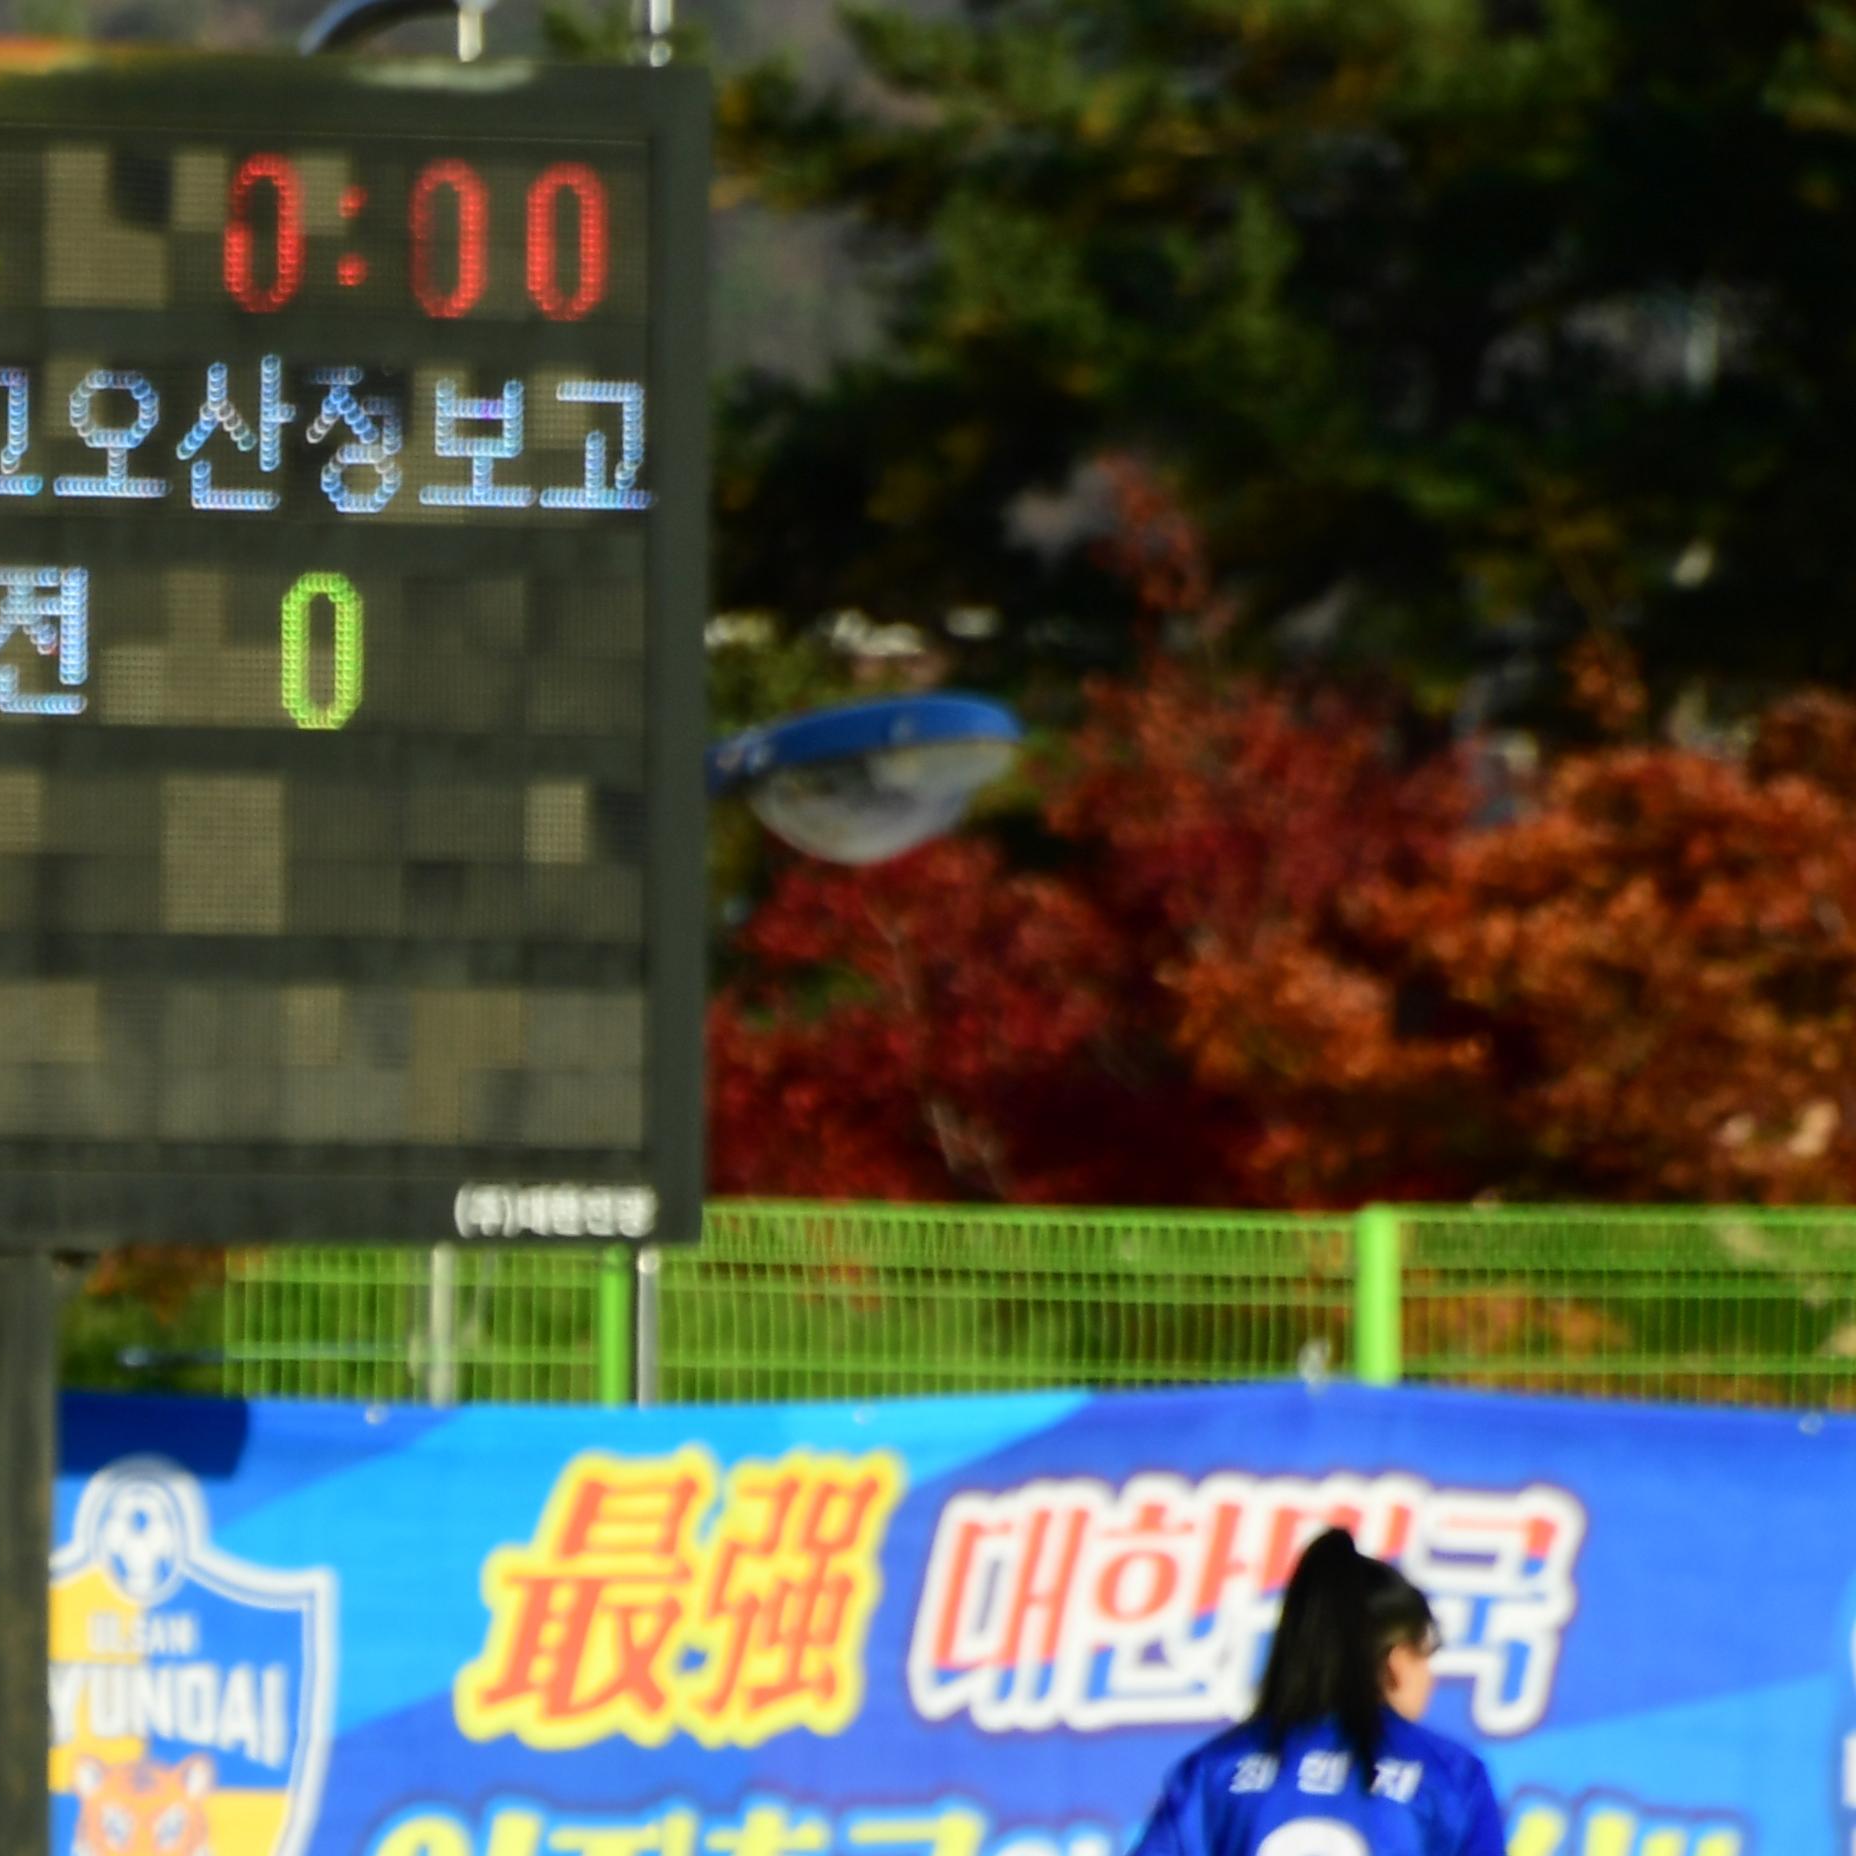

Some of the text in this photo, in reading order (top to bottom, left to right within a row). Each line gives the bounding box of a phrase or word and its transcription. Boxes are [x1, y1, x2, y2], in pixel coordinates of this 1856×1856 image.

[224, 151, 609, 321] 0:00
[280, 571, 363, 730] 0
[50, 1661, 287, 1770] YUNDAI
